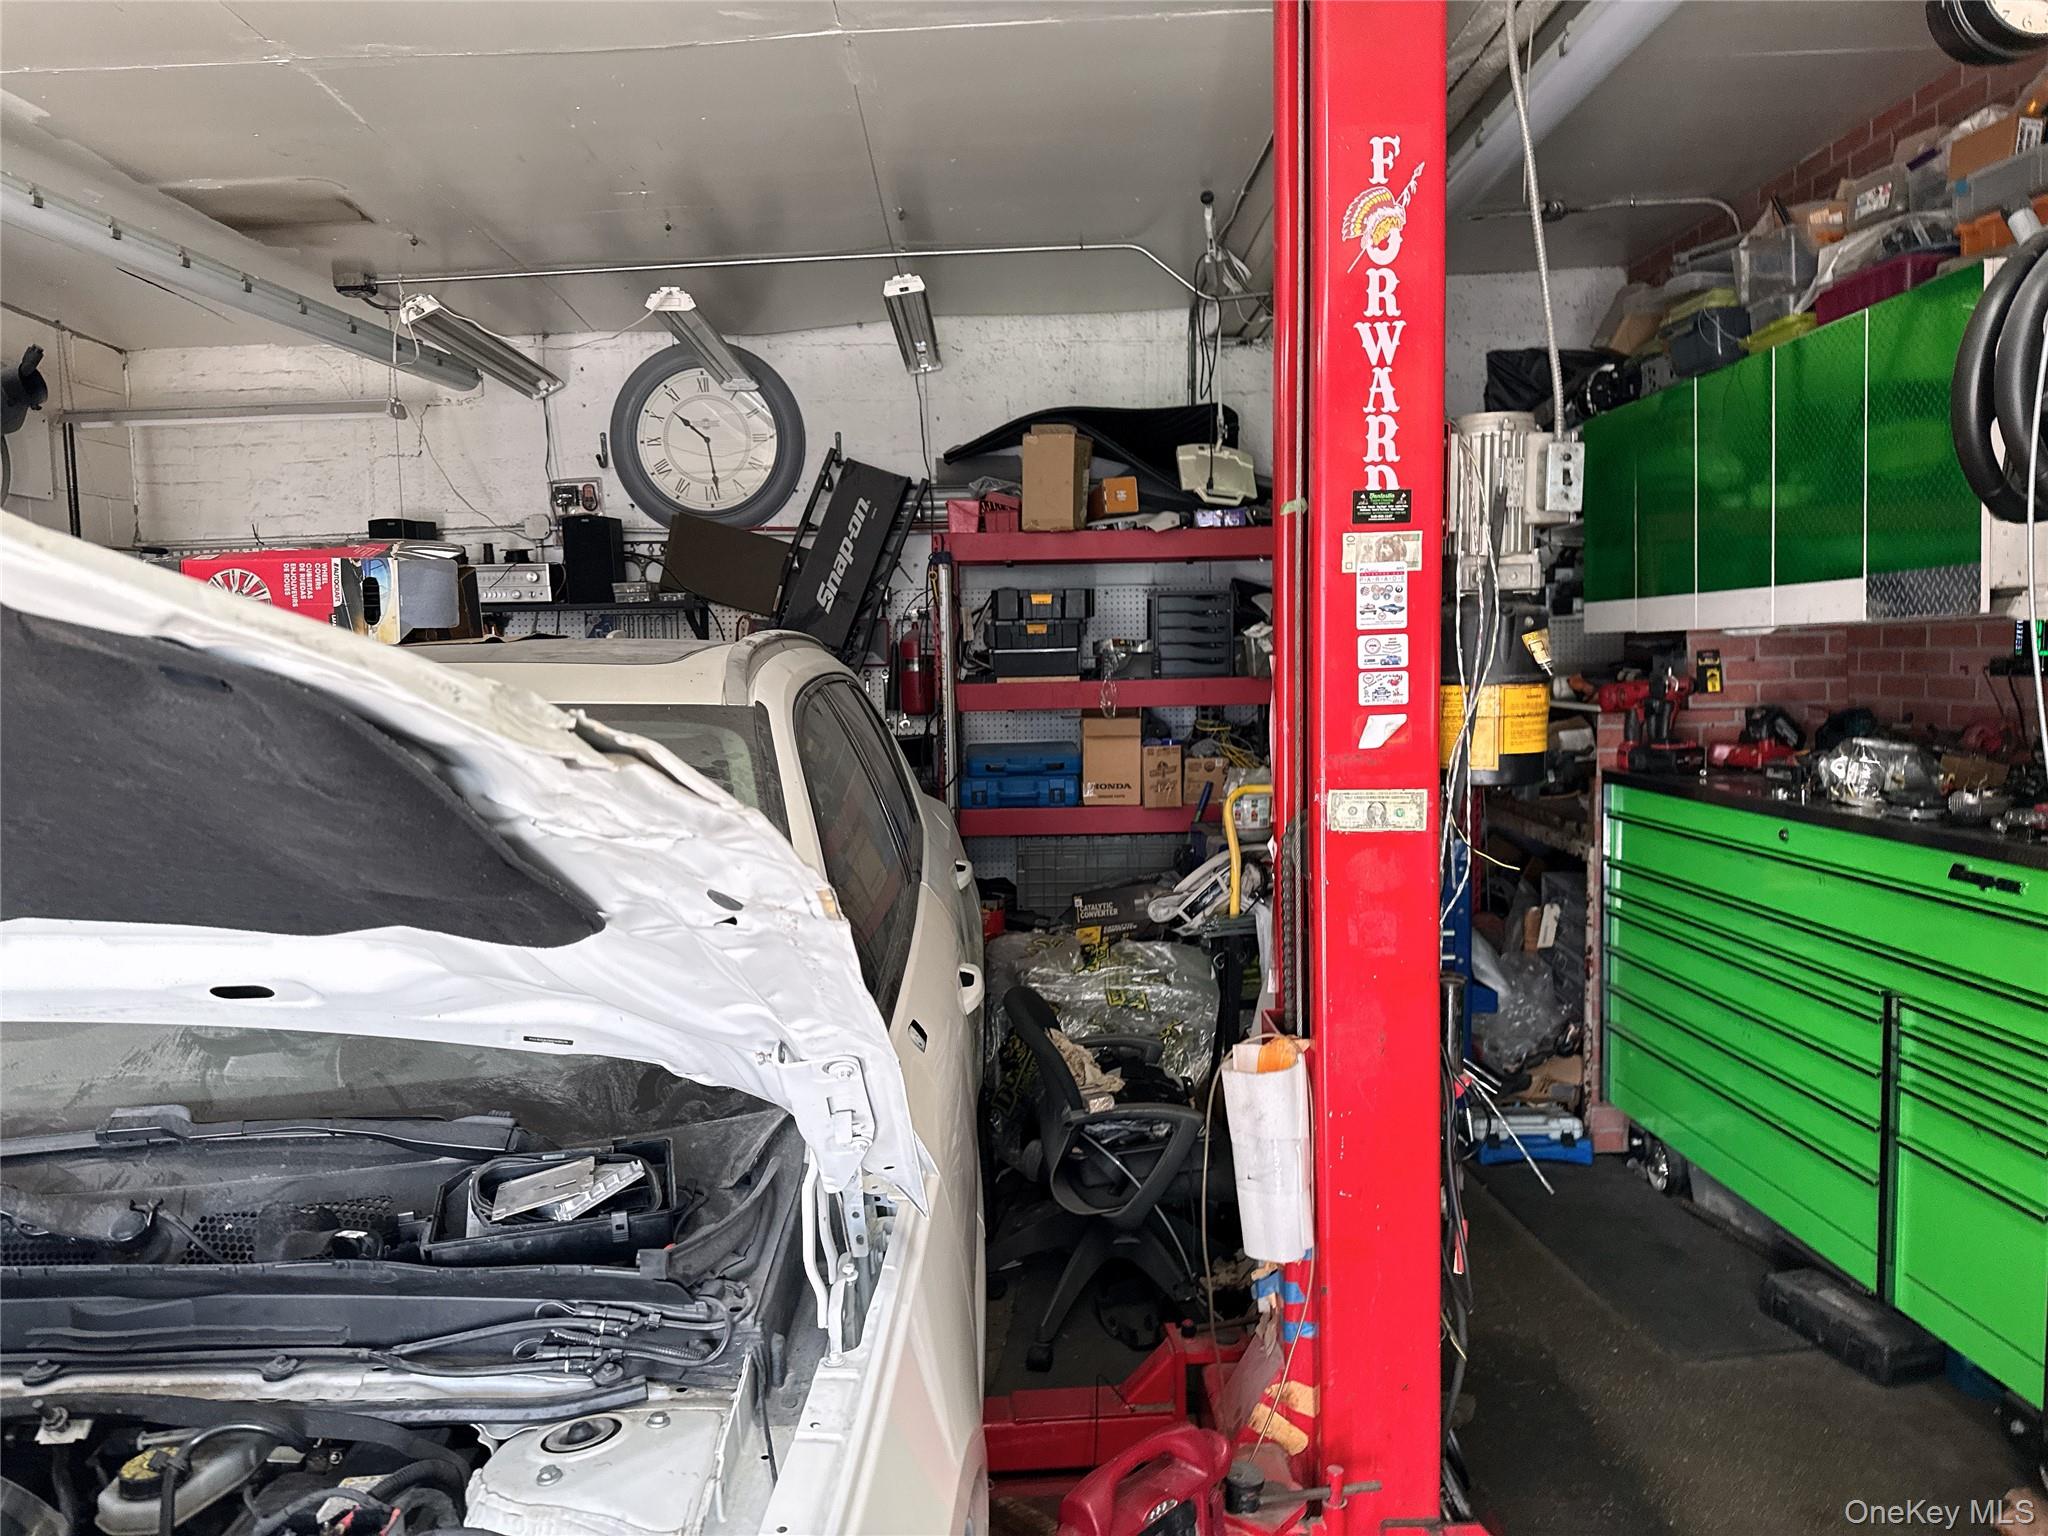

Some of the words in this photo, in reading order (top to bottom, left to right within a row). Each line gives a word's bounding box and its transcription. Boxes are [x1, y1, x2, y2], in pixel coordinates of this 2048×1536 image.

[1353, 135, 1406, 490] FORWARD
[696, 377, 710, 393] XII
[283, 562, 290, 571] DE
[299, 562, 306, 571] DE
[816, 497, 870, 615] Snap-on
[290, 562, 299, 608] ENJOLIVEURS
[299, 573, 307, 600] RUEDAS
[305, 562, 314, 599] CUBIERTAS
[314, 562, 322, 591] COVERS
[321, 562, 329, 585] WHEEL
[332, 566, 341, 602] AUTOCRAFT
[1080, 901, 1114, 912] CATALYTIC
[1080, 908, 1118, 919] CONVERTER
